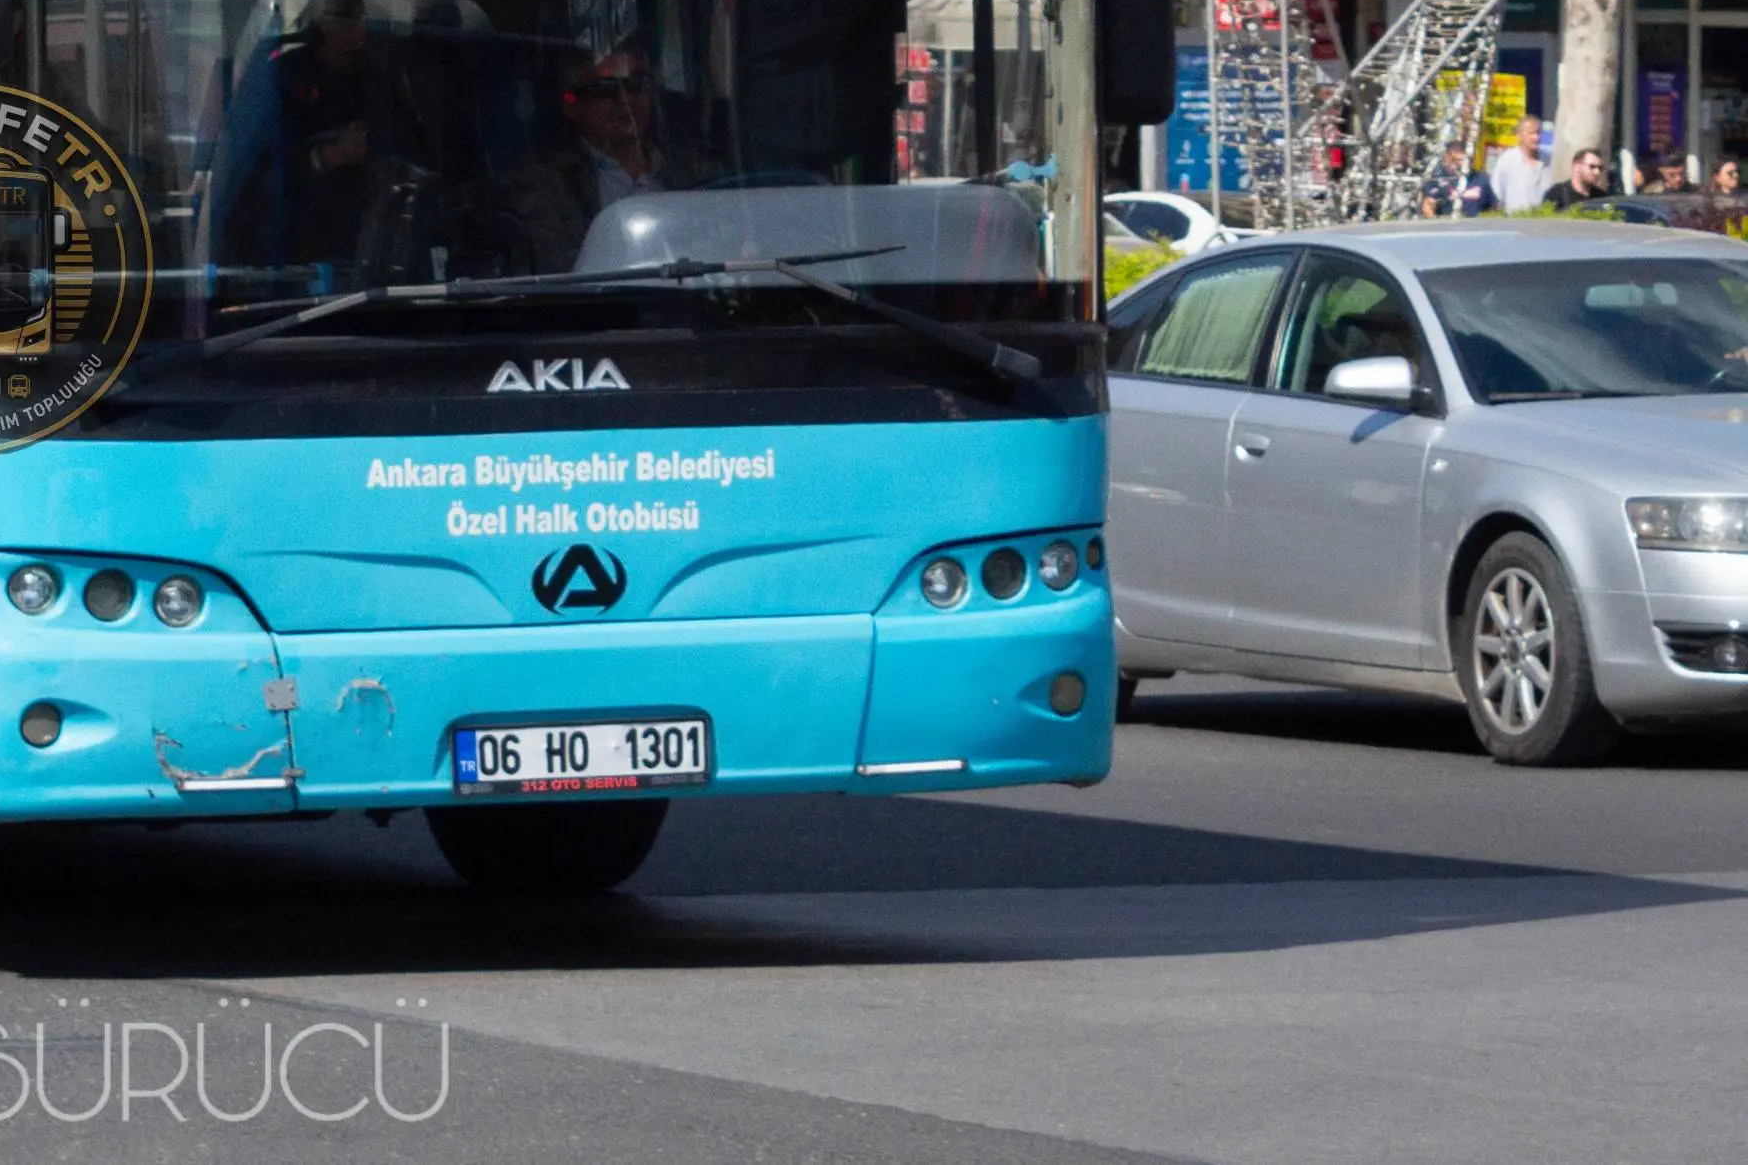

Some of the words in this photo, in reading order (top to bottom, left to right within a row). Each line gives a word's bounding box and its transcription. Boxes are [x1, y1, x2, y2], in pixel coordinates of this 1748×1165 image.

[486, 356, 632, 394] AKIA
[366, 457, 466, 490] Ankara
[474, 452, 628, 491] Büyükşehir
[636, 448, 775, 486] Belediyesi
[446, 500, 507, 537] Özel
[515, 505, 578, 534] Halk
[586, 500, 700, 533] Otobüsü
[460, 759, 476, 772] TR
[478, 734, 521, 775] 06
[625, 726, 700, 770] 1301
[522, 780, 547, 792] 312
[551, 778, 580, 791] OTO
